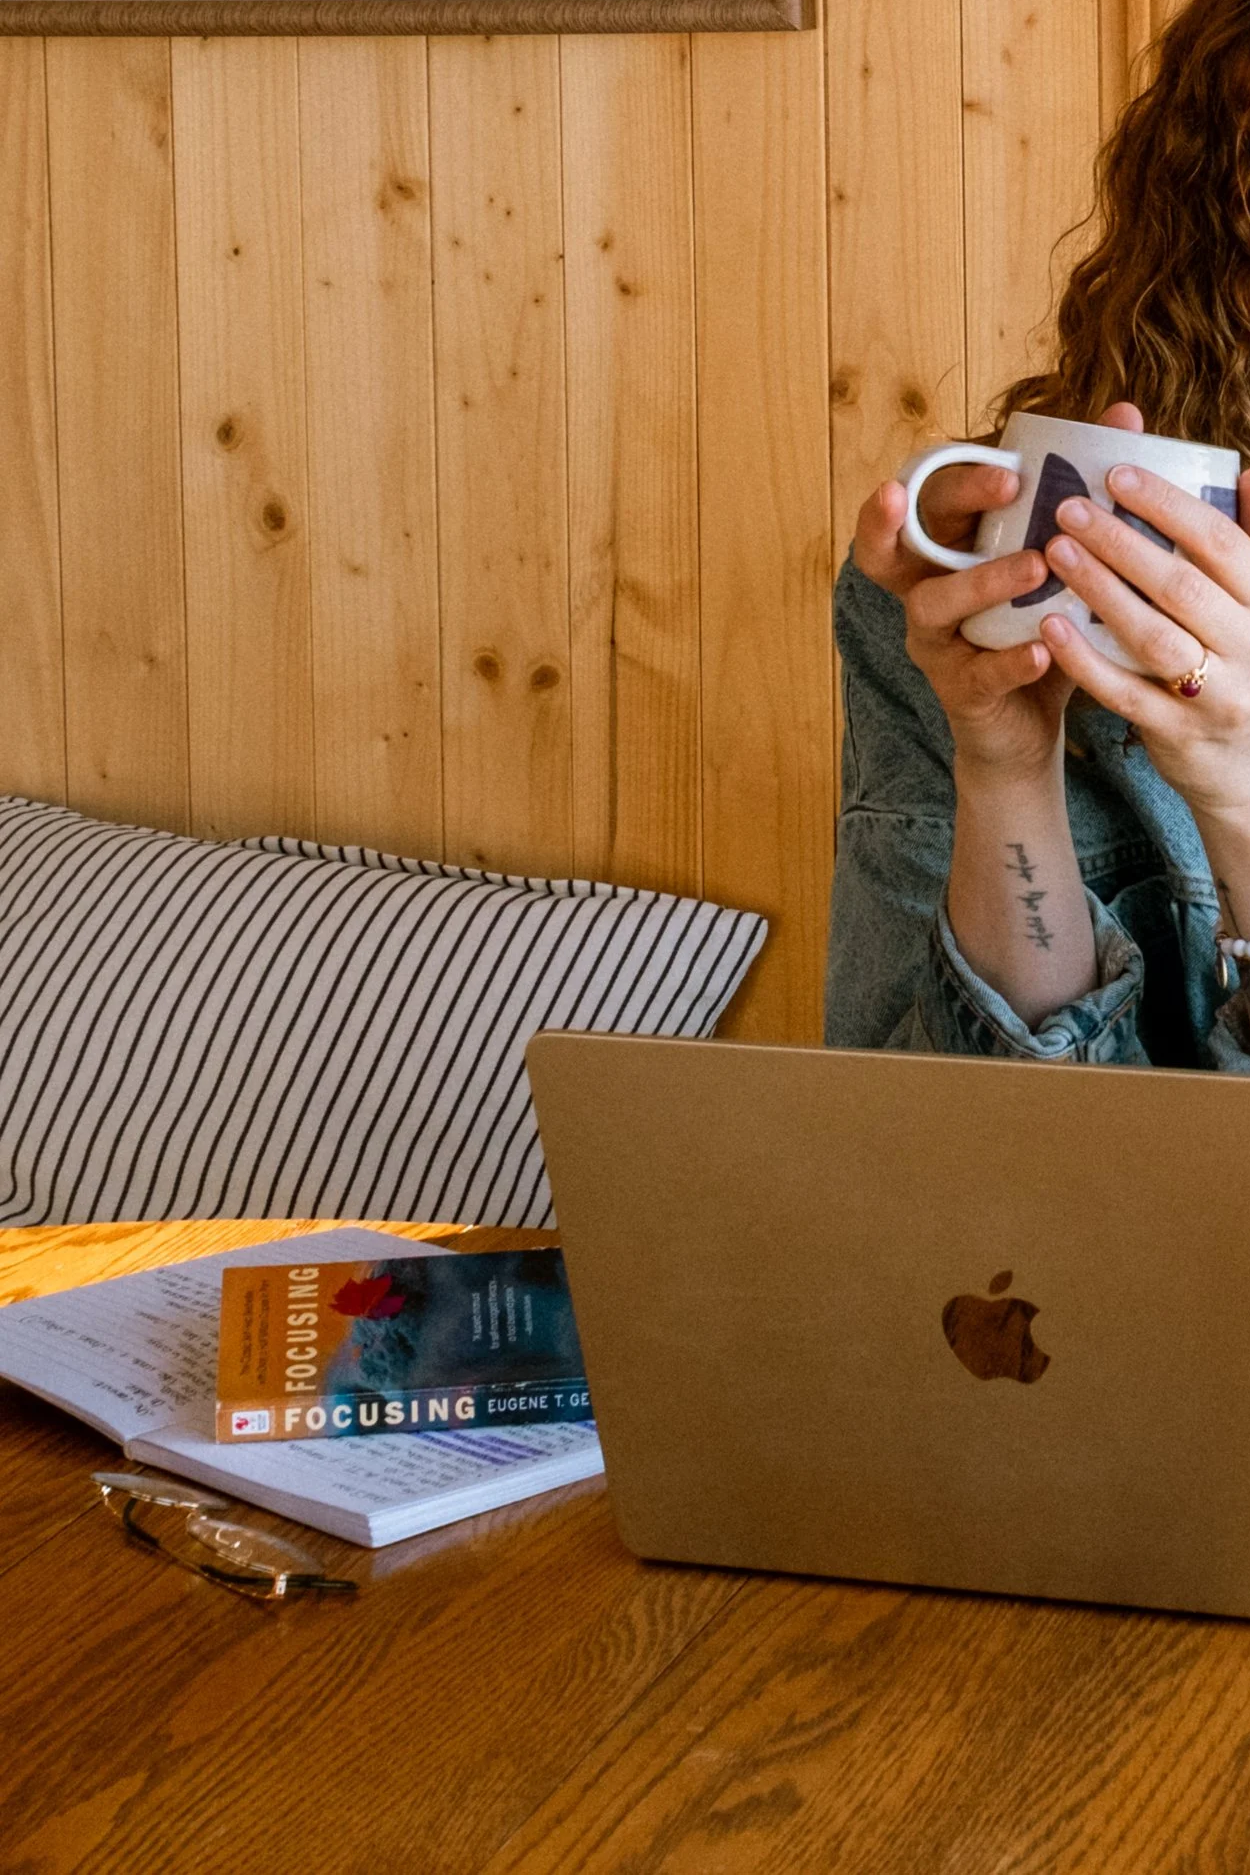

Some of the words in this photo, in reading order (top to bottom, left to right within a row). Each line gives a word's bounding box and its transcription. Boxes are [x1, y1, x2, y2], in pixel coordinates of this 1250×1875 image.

[285, 1267, 319, 1393] FOCUSING
[284, 1396, 476, 1432] FOCUSING
[487, 1395, 549, 1413] EUGENE
[553, 1393, 565, 1408] T.
